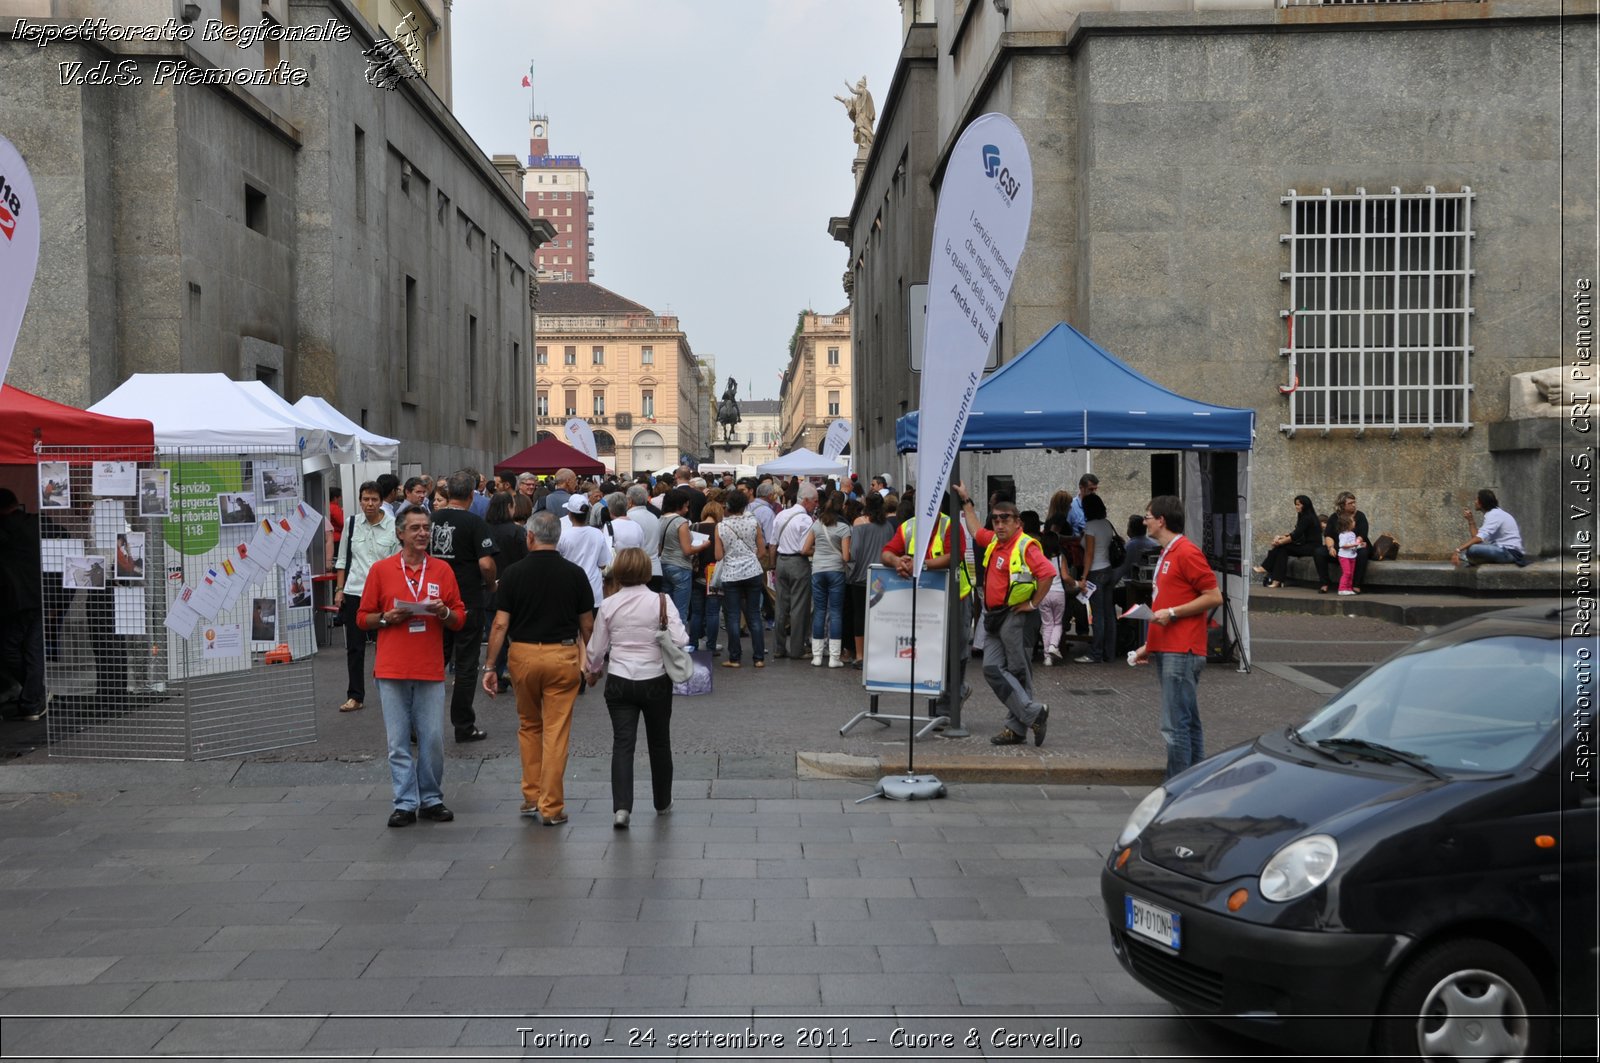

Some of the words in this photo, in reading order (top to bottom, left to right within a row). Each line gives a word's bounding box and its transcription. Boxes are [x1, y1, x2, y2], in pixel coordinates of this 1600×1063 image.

[964, 238, 977, 259] che
[975, 254, 1005, 302] migliorano
[969, 209, 975, 222] I
[972, 217, 993, 248] servizi
[990, 241, 1013, 281] internet
[944, 238, 952, 255] la
[951, 251, 972, 285] qualità
[971, 280, 986, 306] della
[985, 300, 997, 324] vita.
[950, 283, 972, 318] Anche
[970, 310, 978, 328] la
[977, 322, 989, 347] tua.
[926, 371, 979, 518] www.csipiemonte.it
[168, 509, 219, 524] Territoriale
[172, 481, 211, 495] Servizio
[184, 524, 204, 537] 118
